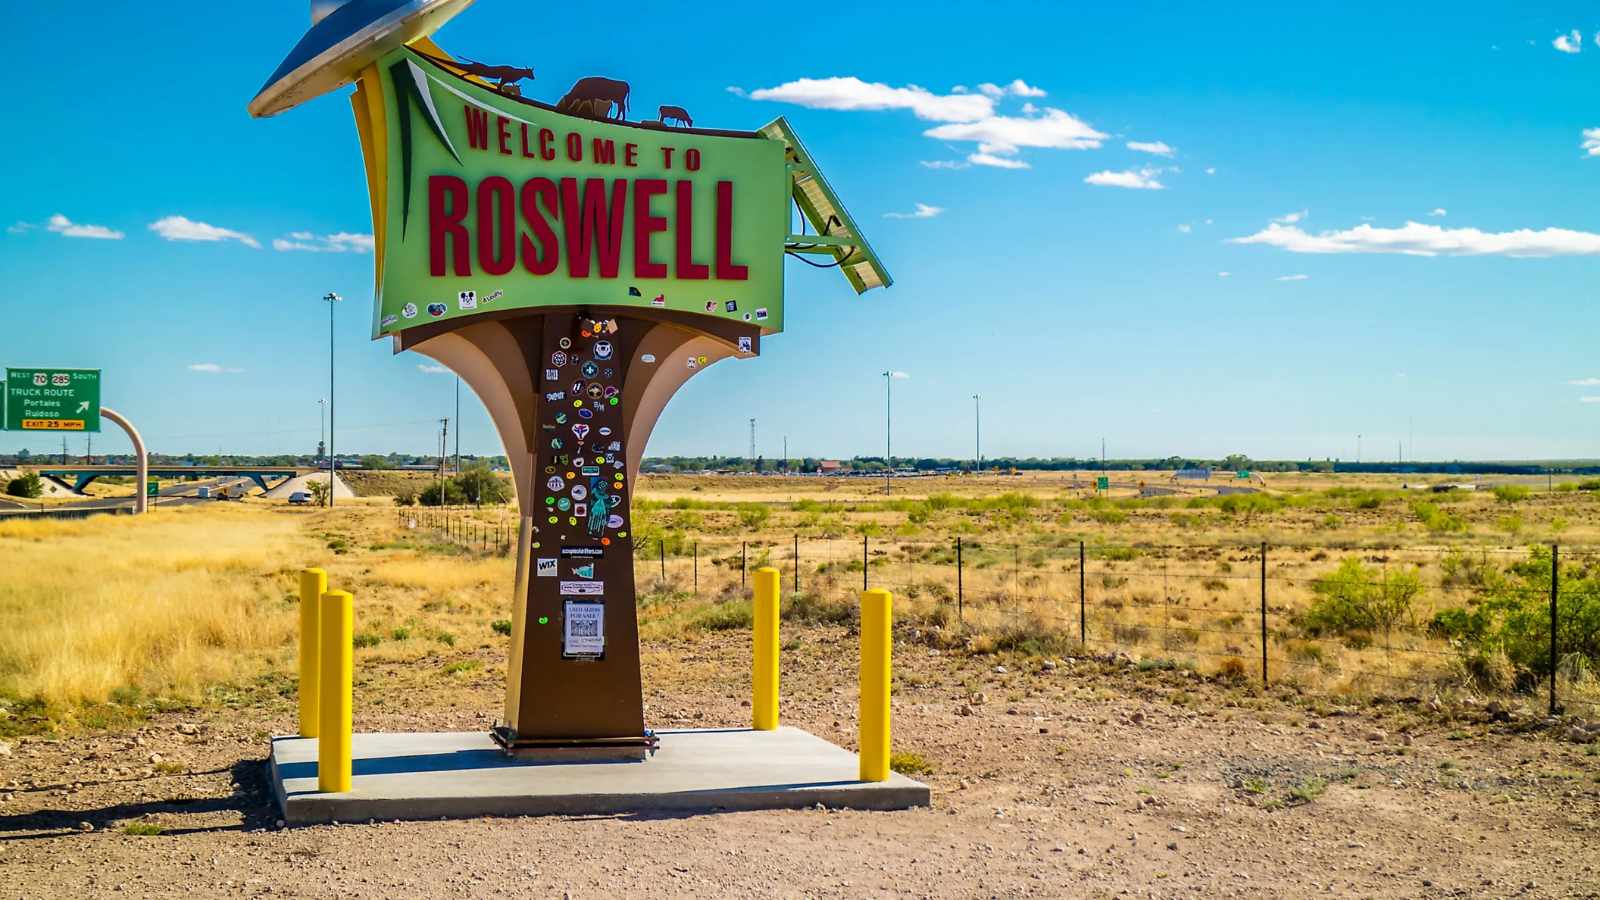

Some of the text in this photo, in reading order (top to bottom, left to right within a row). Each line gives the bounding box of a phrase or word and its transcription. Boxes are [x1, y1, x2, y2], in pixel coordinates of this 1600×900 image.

[464, 105, 701, 171] WELCOME TO
[428, 175, 749, 280] ROSWELL
[35, 375, 46, 384] 70
[53, 375, 69, 384] 285
[10, 388, 75, 397] TRUCK ROUTE
[24, 399, 61, 407] Portales
[539, 560, 556, 570] WIX
